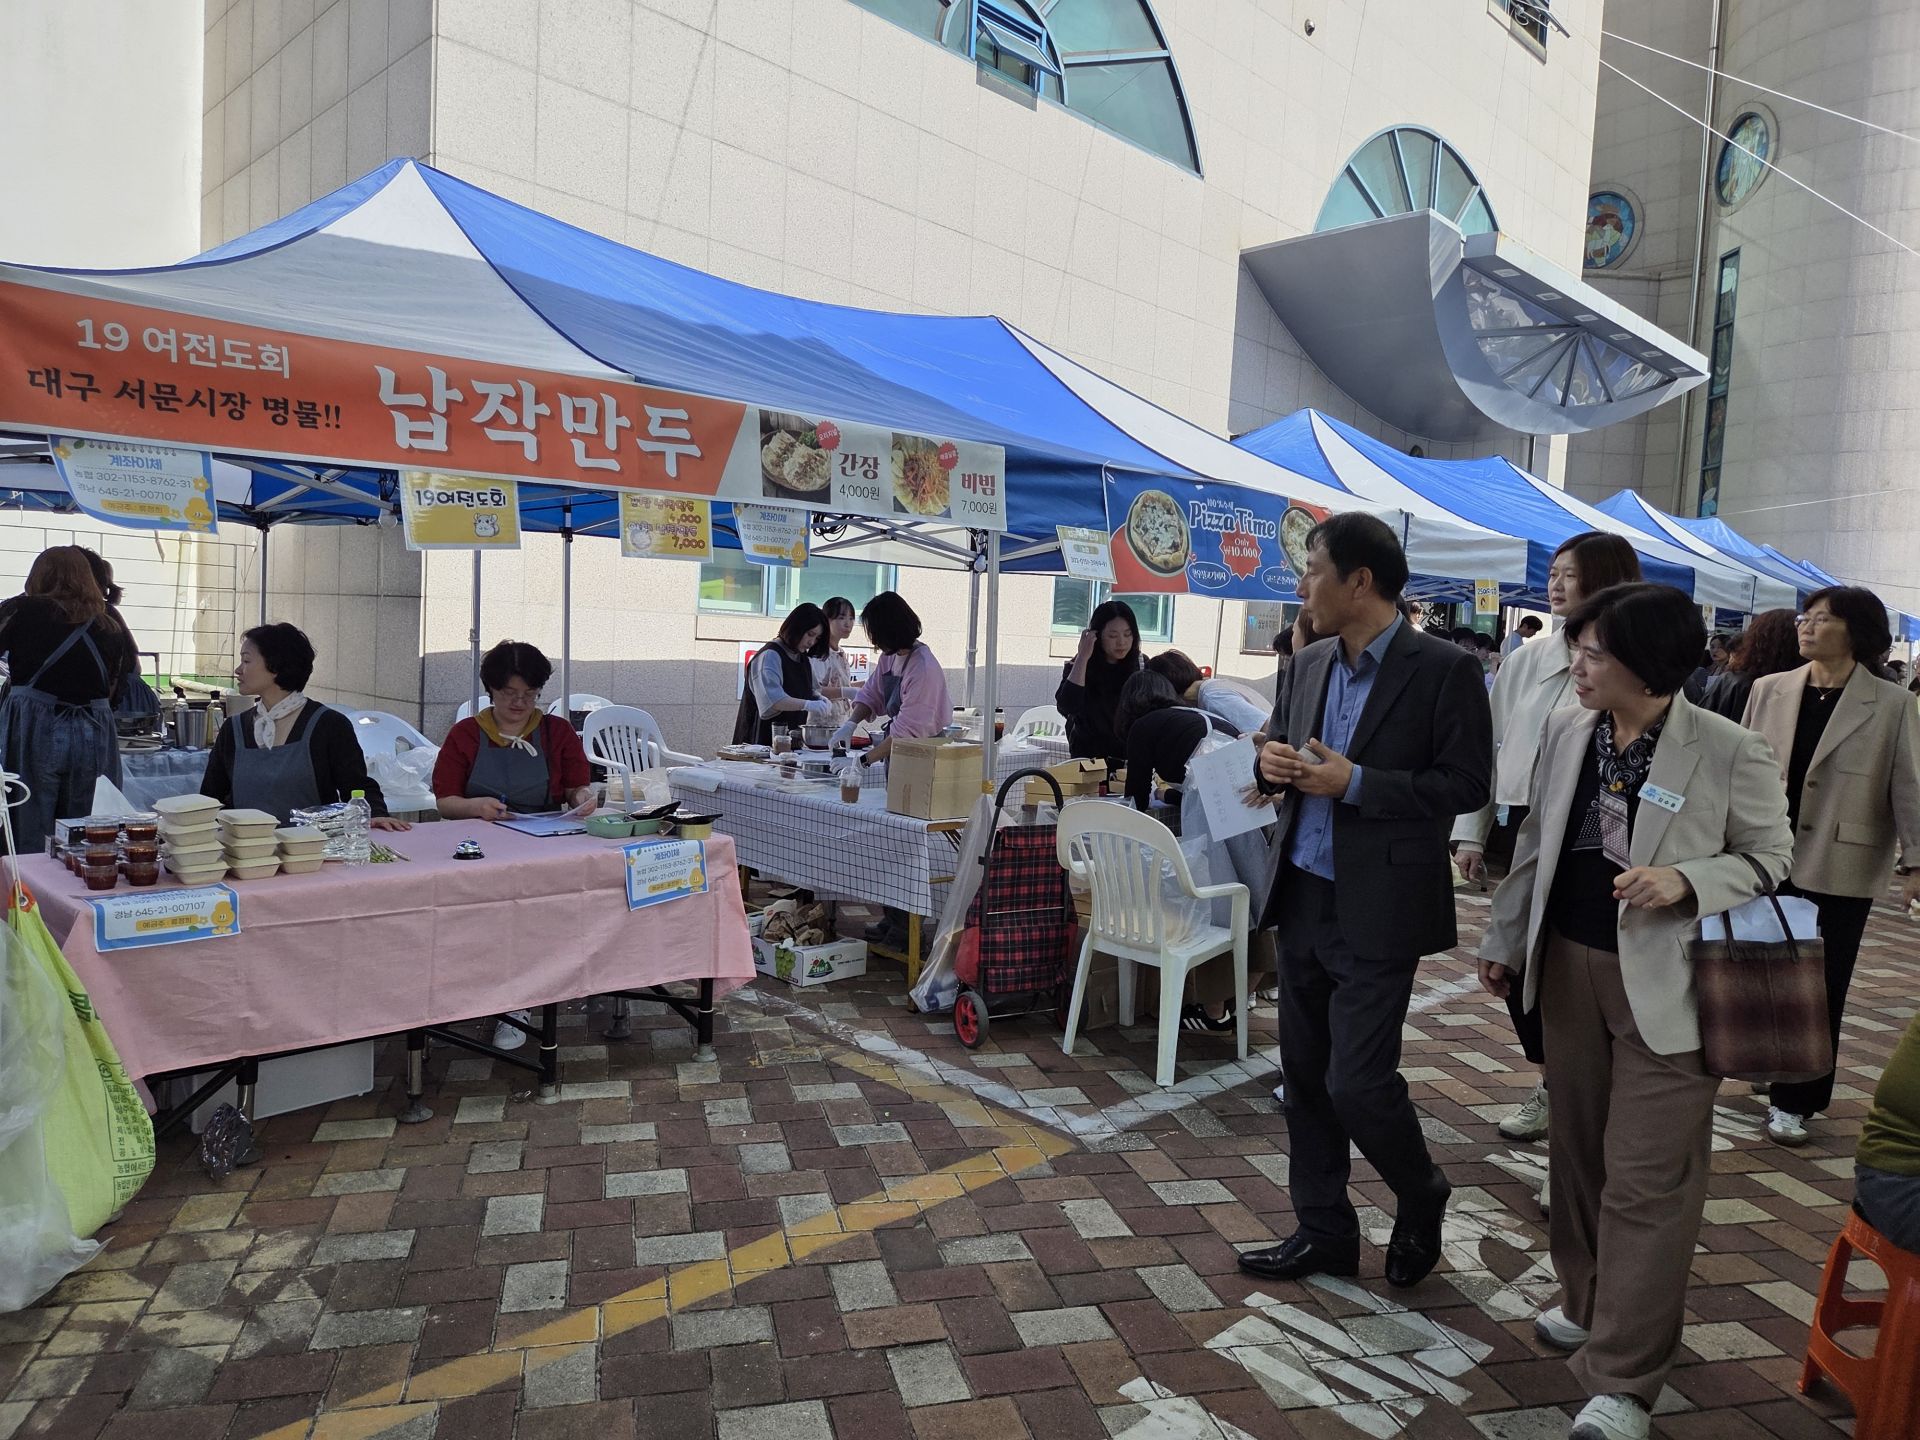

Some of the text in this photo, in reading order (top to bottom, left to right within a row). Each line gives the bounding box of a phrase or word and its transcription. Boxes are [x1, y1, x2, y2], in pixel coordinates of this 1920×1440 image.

[76, 319, 291, 379] 19 여전도회
[27, 367, 341, 430] 대구 서문시장 명물!!
[374, 365, 702, 478] 납작만두
[108, 454, 162, 471] 계좌이체
[839, 452, 880, 480] 간장
[96, 472, 191, 488] 302-1153-8762-31
[961, 472, 996, 497] 비빔
[99, 487, 177, 501] 645-21-007107
[415, 489, 506, 509] 19여전도회
[840, 484, 880, 500] 4,000원
[961, 500, 998, 515] 7,000원
[1189, 501, 1276, 539] Pizza Time
[672, 535, 705, 549] 7,000
[1235, 538, 1250, 547] Only
[135, 901, 206, 916] 645-21-007107
